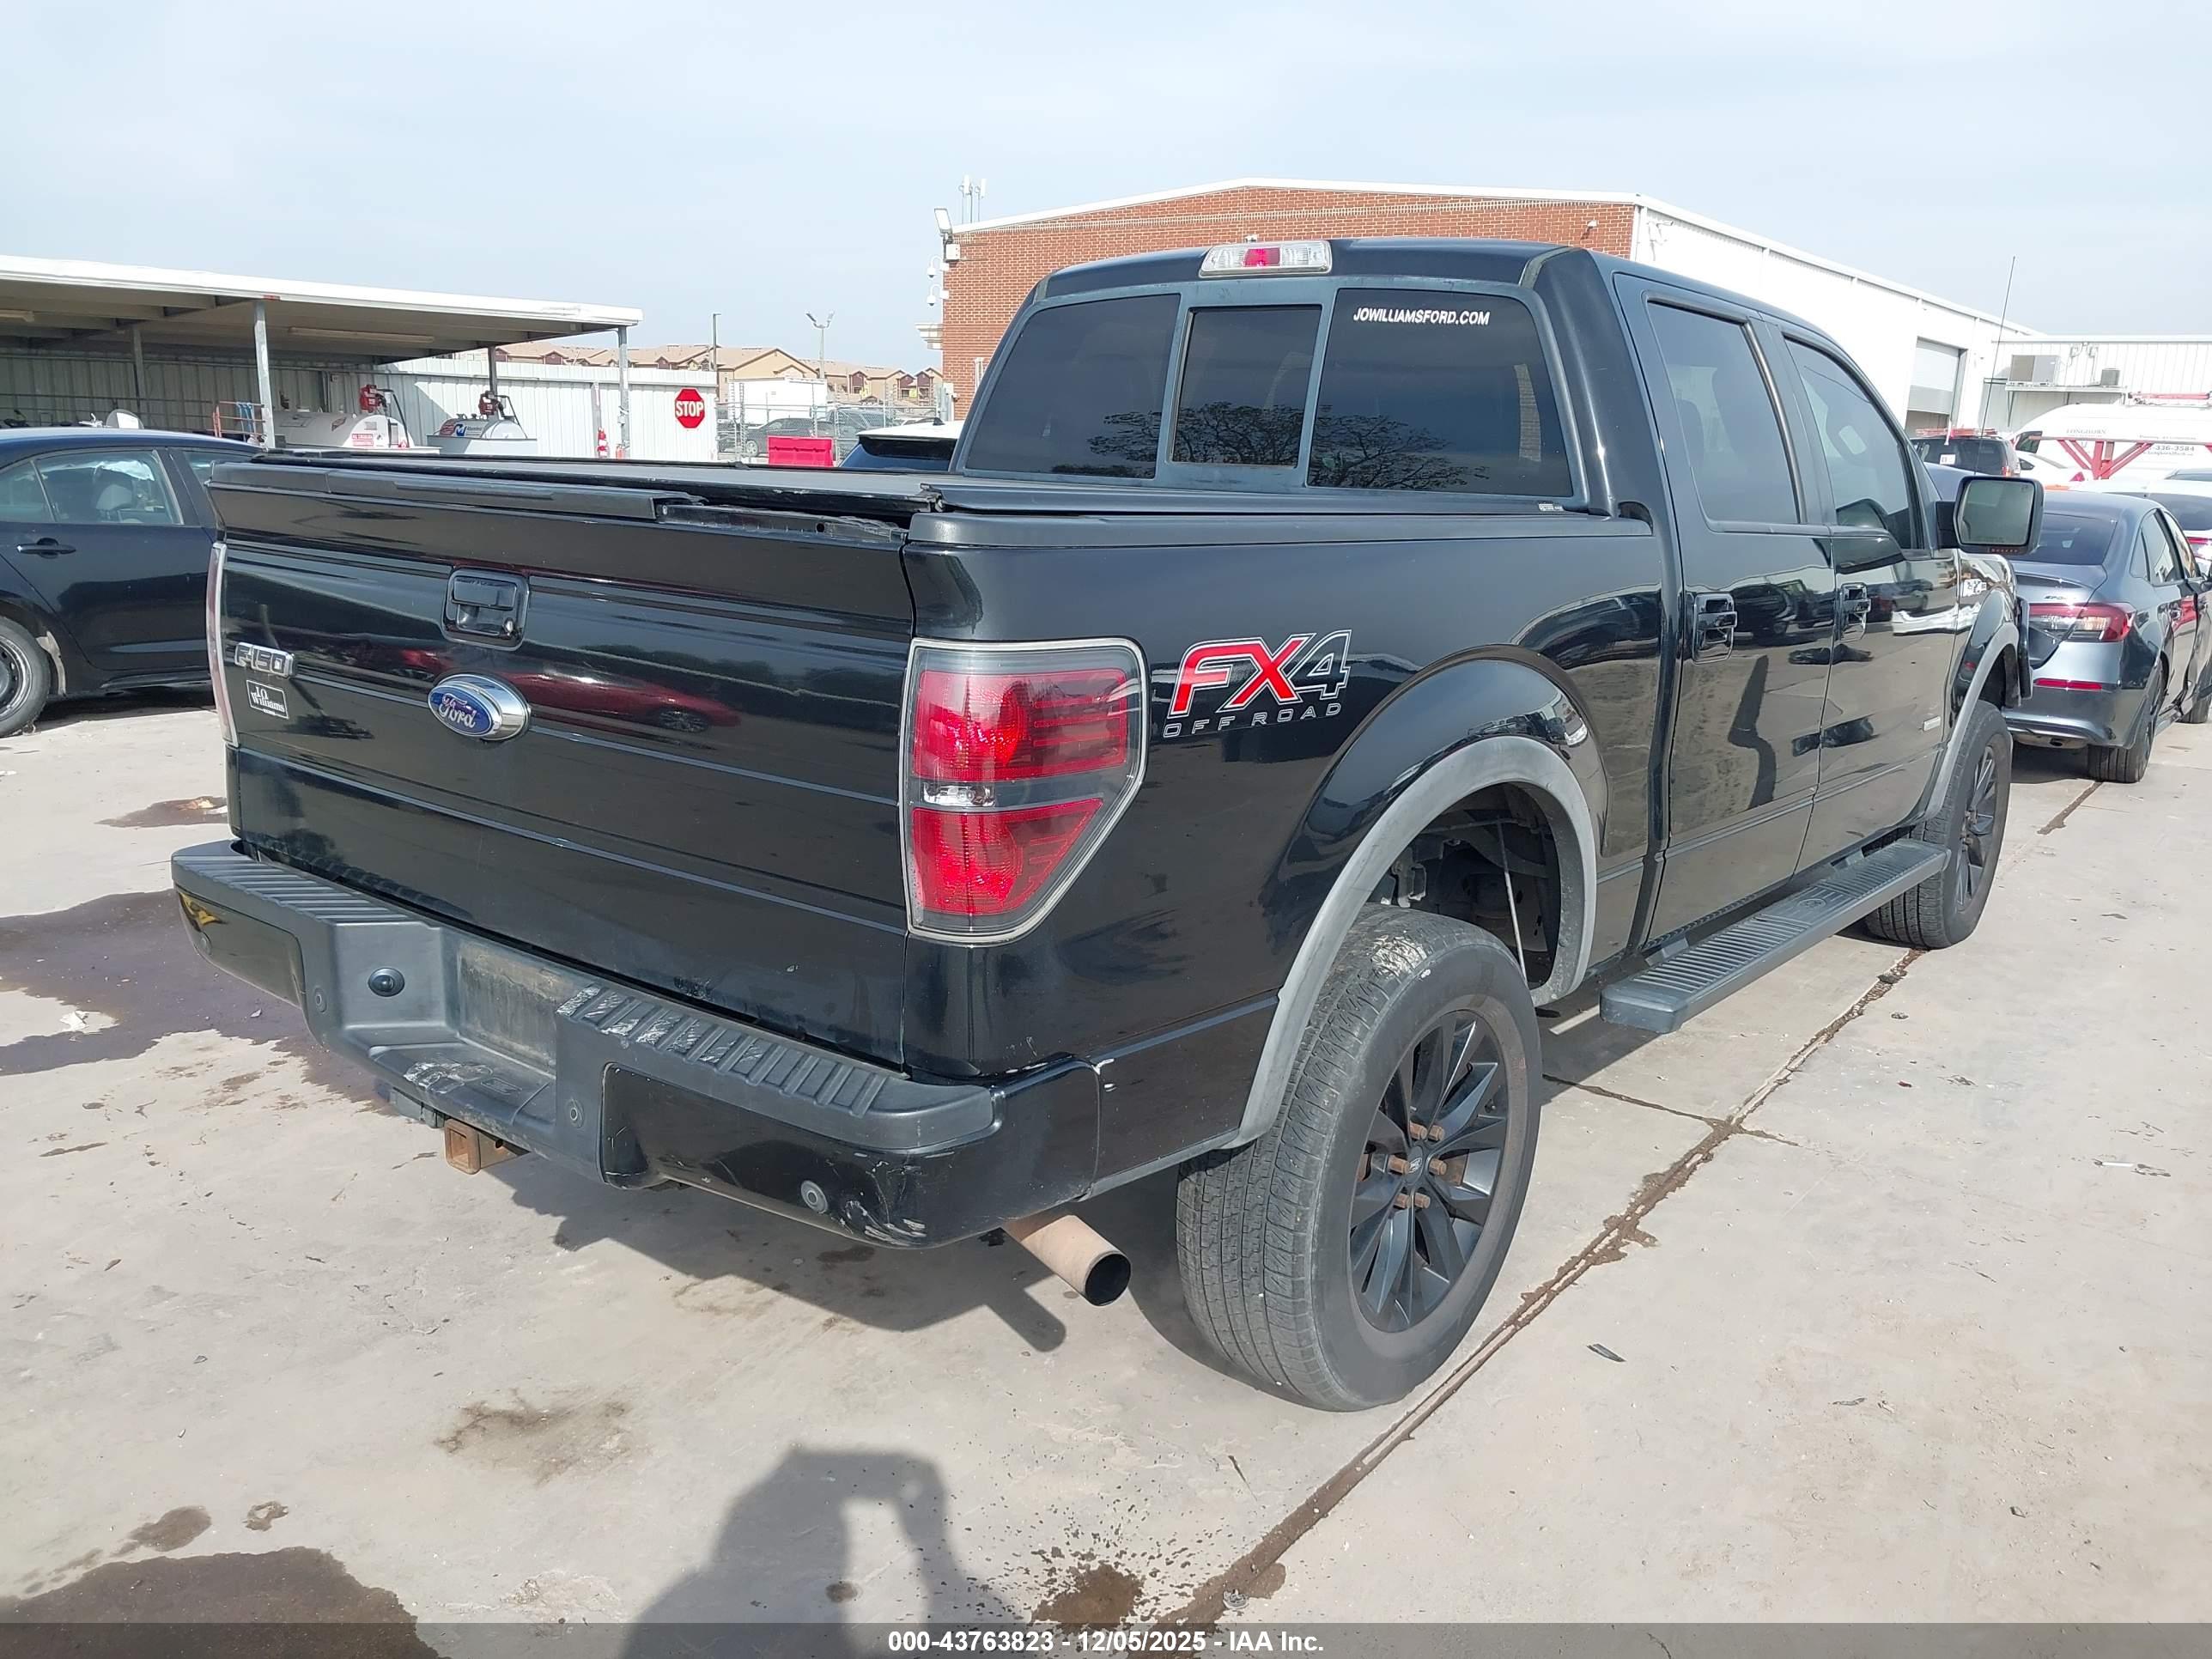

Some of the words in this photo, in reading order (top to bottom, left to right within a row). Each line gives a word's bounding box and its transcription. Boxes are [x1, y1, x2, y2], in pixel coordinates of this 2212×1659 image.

[1353, 307, 1490, 325] JOWILLIAMSFORD.COM
[676, 401, 704, 417] STOP
[1167, 629, 1352, 720] FX4
[250, 691, 285, 713] Williams
[439, 692, 477, 728] Ford
[1163, 715, 1236, 738] OFF
[1251, 702, 1342, 726] ROAD
